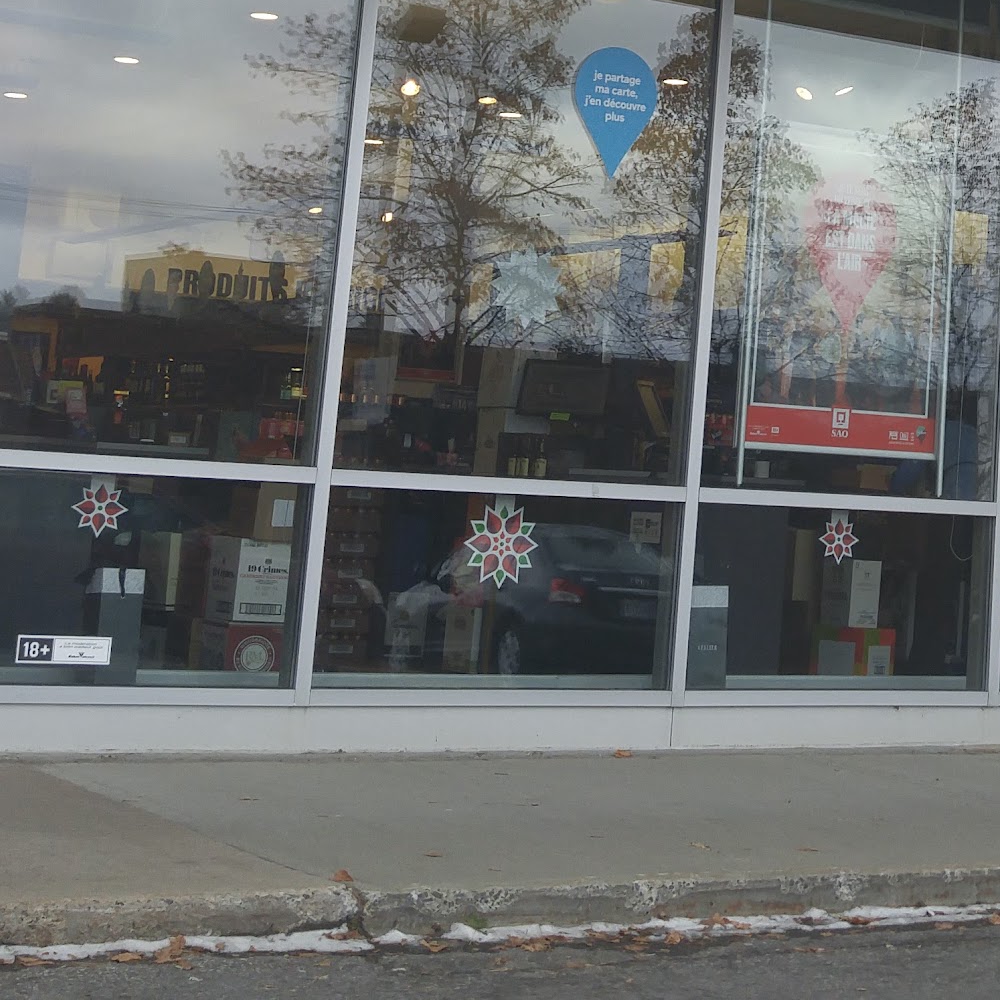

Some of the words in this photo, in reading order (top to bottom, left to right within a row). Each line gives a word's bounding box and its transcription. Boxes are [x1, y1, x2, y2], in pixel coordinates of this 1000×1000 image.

[593, 69, 603, 81] je
[604, 73, 641, 86] partage
[594, 85, 610, 94] ma
[611, 87, 638, 99] carte,
[603, 97, 646, 112] découvre
[604, 111, 625, 122] plus
[248, 564, 257, 573] 19
[23, 641, 51, 658] 18+
